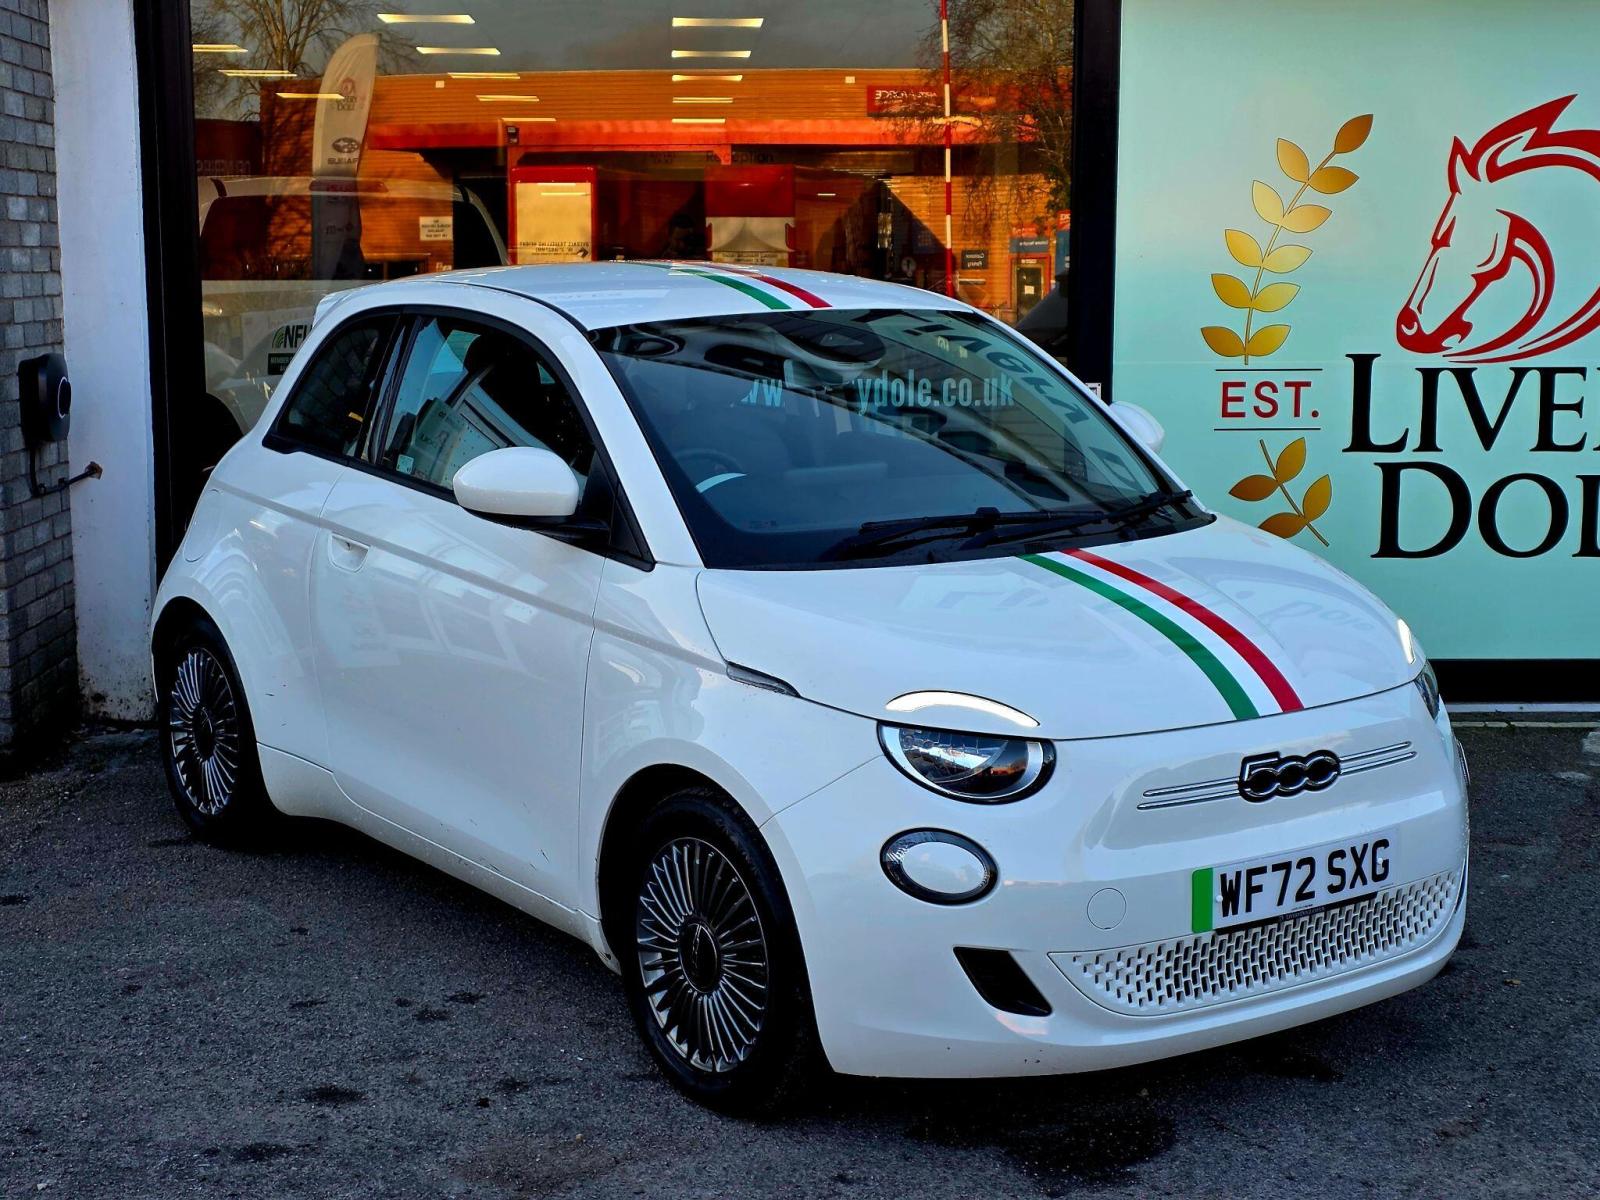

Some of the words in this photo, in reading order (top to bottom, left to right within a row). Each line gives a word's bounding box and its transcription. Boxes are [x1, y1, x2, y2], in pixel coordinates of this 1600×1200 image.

[705, 151, 774, 164] Reeption
[1221, 381, 1320, 418] EST.
[1342, 353, 1600, 453] LIVE
[1238, 749, 1341, 803] 500
[1220, 856, 1316, 918] WF72
[1327, 838, 1391, 895] SXG
